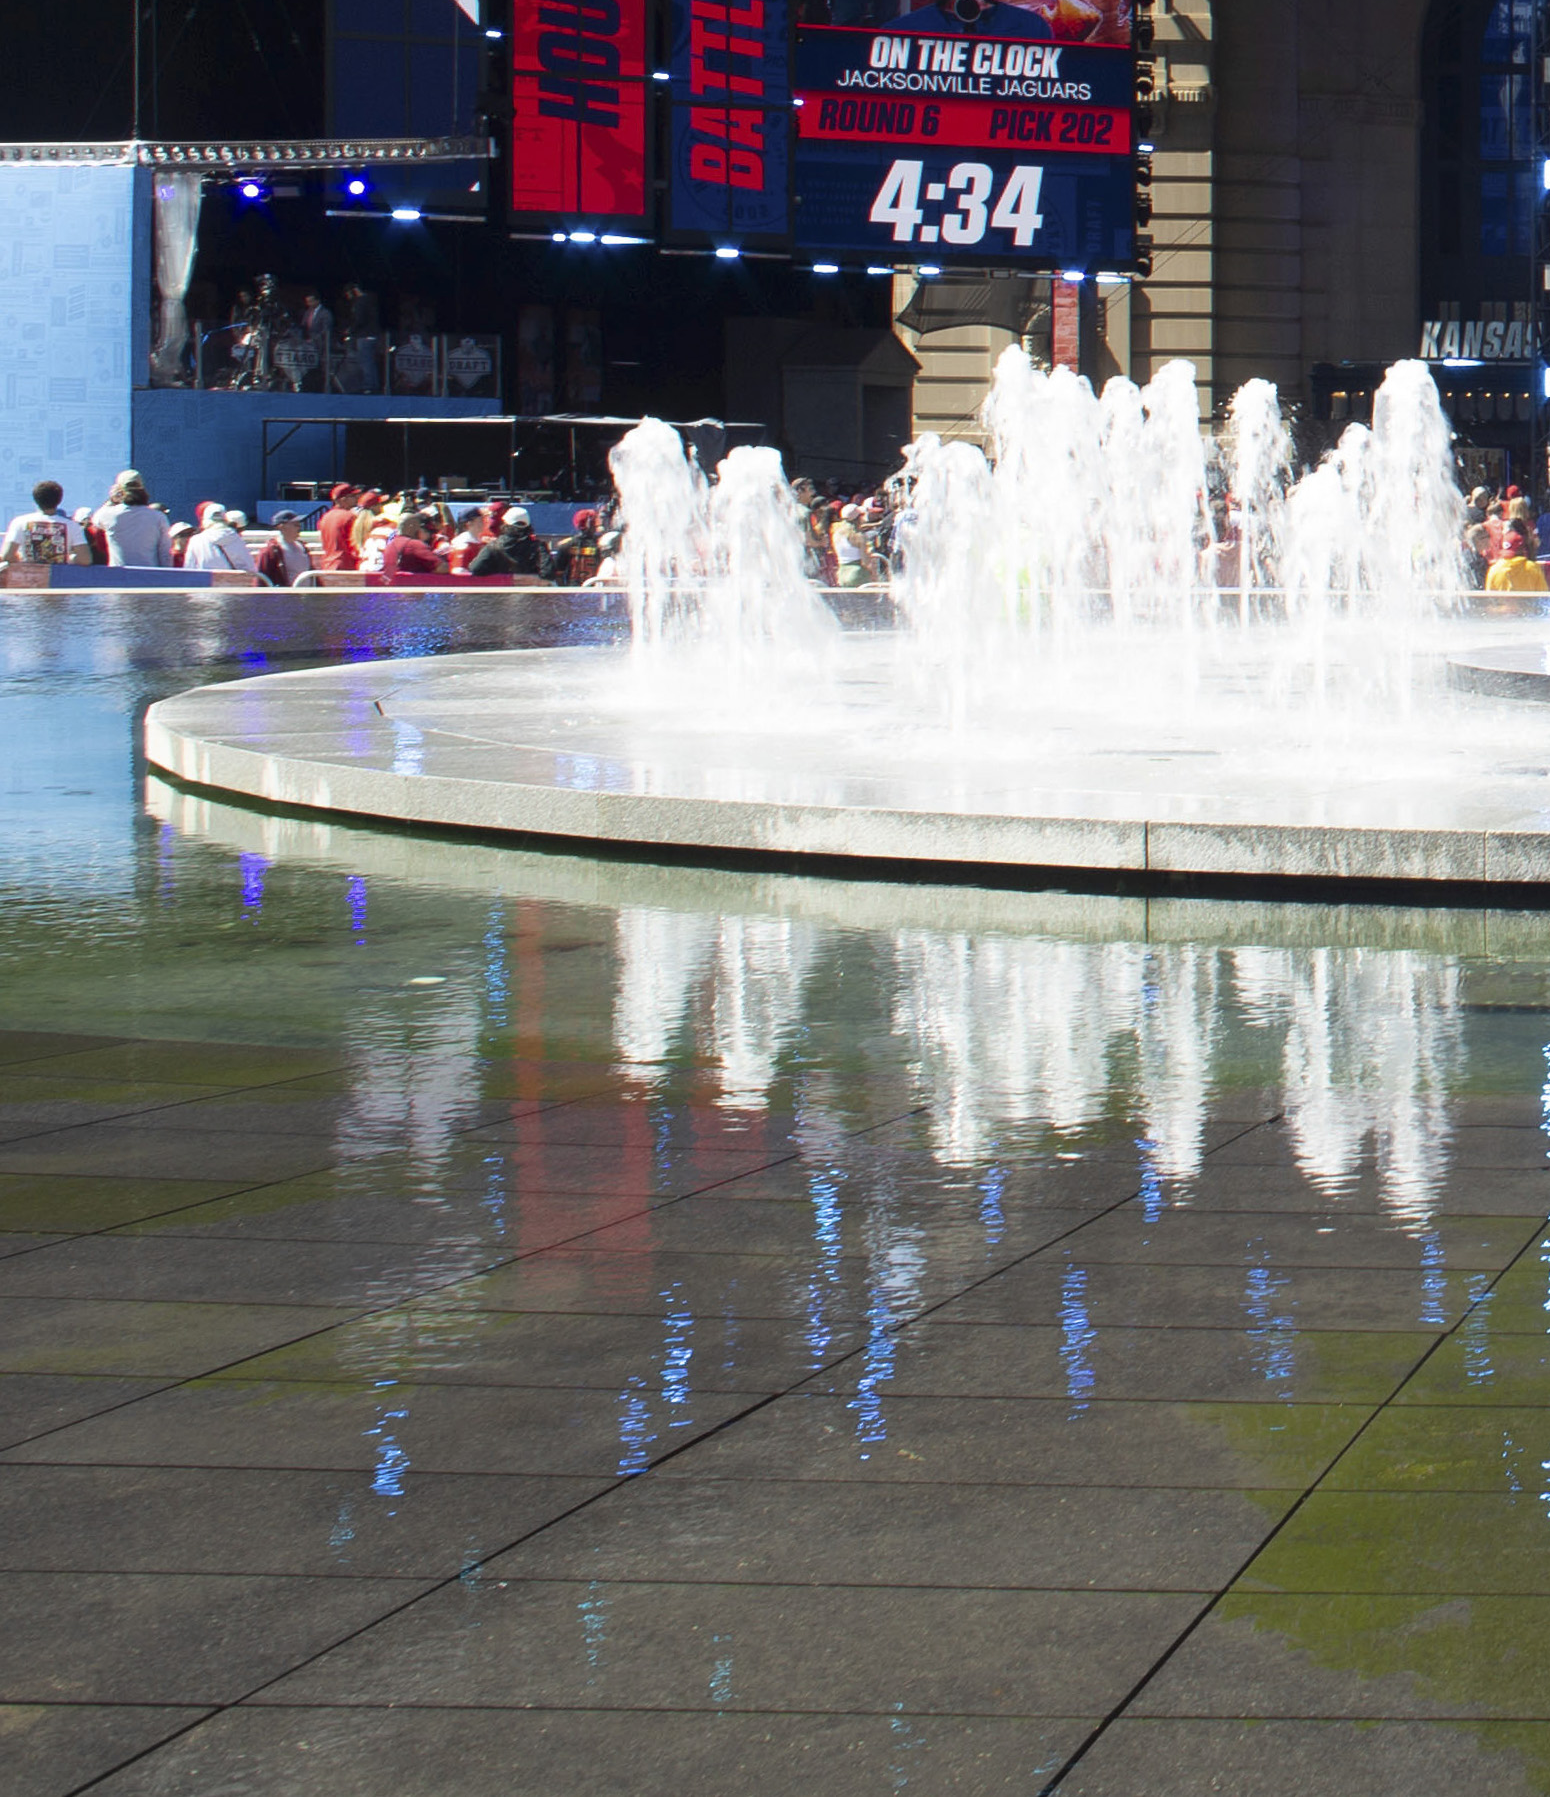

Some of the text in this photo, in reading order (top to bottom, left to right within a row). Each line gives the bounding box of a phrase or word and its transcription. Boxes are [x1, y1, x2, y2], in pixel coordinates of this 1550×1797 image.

[869, 35, 1062, 78] ON THE CLOCK
[835, 69, 1092, 101] JACKSONVILLE JAGUARS
[819, 99, 1113, 145] ROUND 6 PICK 202
[868, 160, 1044, 246] 4:34
[1420, 320, 1541, 360] KANSAS
